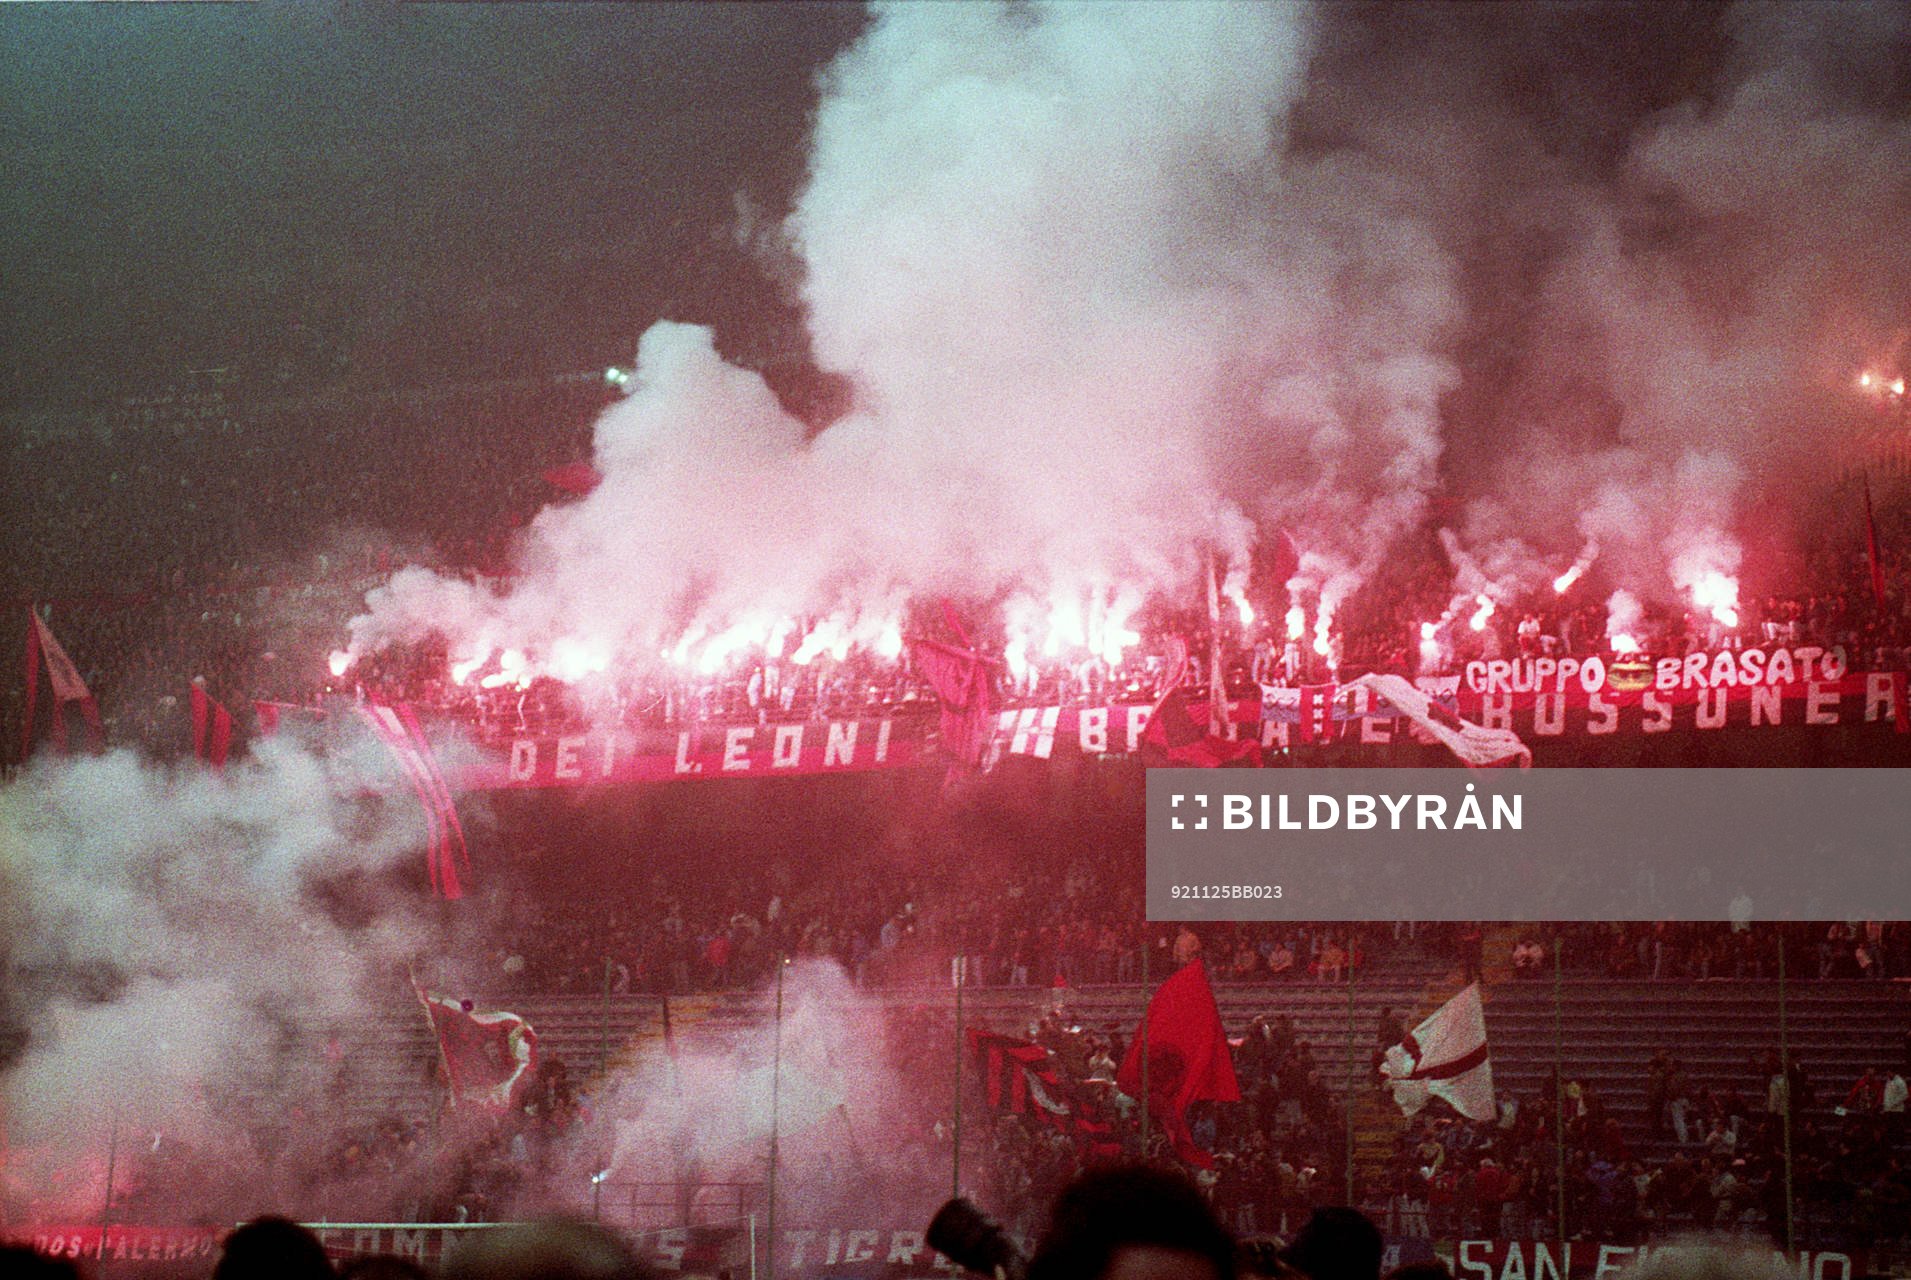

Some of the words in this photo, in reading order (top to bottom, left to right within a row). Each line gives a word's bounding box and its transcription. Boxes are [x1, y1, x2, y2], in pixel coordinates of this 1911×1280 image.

[1466, 657, 1605, 694] GRUPPO
[1656, 645, 1847, 690] BRASATO
[509, 734, 617, 781] DEI
[674, 719, 892, 774] LEONI
[1459, 1240, 1572, 1280] SAN
